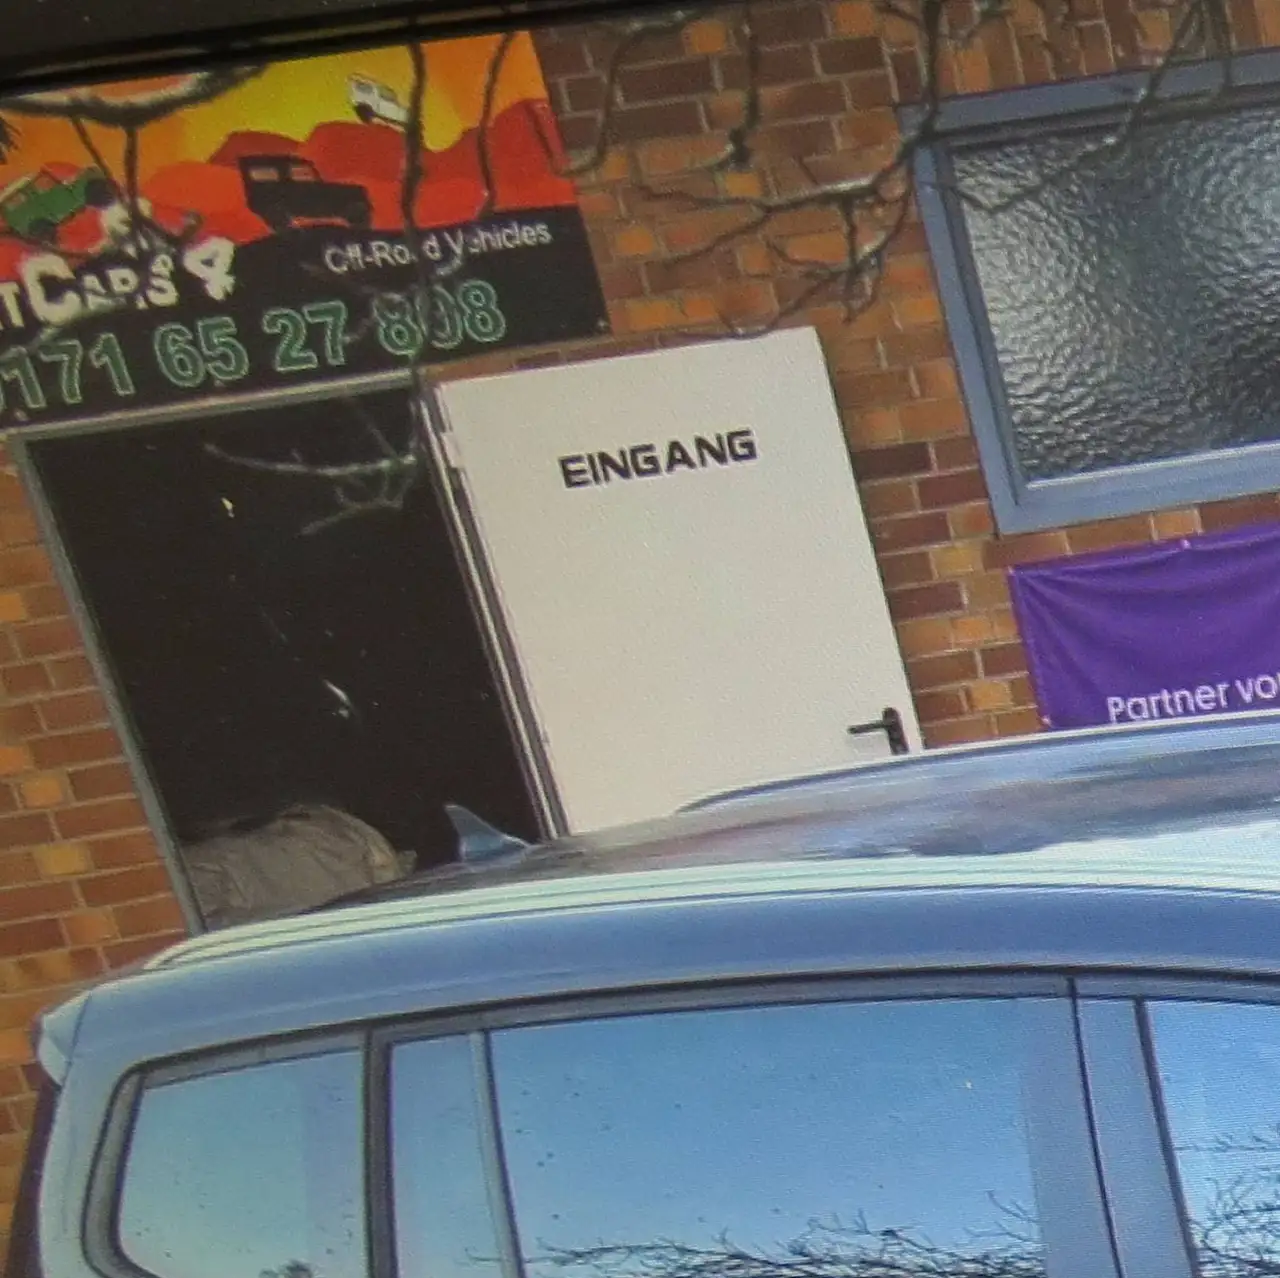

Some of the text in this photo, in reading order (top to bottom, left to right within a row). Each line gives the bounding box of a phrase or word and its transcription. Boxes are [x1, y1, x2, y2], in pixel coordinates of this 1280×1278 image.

[0, 279, 507, 411] 171 65 27 808
[558, 428, 758, 488] EINGANG
[1107, 683, 1230, 723] Partner
